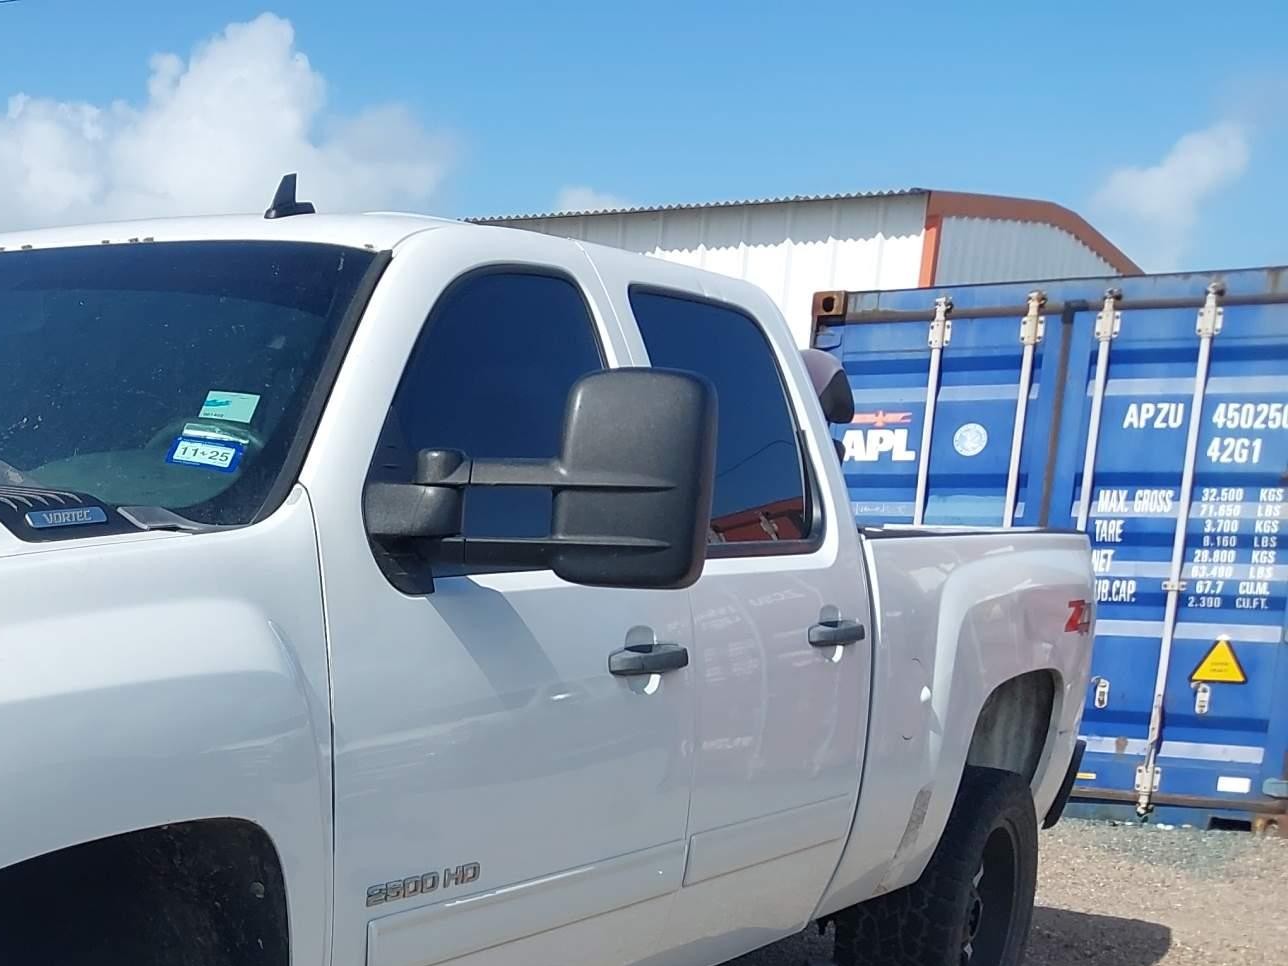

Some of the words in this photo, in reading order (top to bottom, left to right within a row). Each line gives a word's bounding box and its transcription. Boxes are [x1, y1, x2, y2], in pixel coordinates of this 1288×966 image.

[1123, 403, 1184, 429] APZU
[842, 428, 915, 462] APL
[1207, 437, 1262, 464] 42G1
[1097, 489, 1129, 512] MAX.
[1133, 489, 1174, 513] GROSS
[1201, 487, 1244, 502] 32.500
[1259, 488, 1284, 502] KGS
[1257, 504, 1281, 517] LBS
[43, 509, 92, 524] VORTEC
[1094, 519, 1124, 542] TARE
[1204, 519, 1239, 533] 3.700
[1255, 520, 1279, 534] KGS
[1253, 536, 1277, 548] LBS
[1091, 549, 1115, 572] NET
[1251, 550, 1276, 564] KGS
[1248, 566, 1273, 579] LBS
[1195, 580, 1224, 594] 67.7
[365, 871, 440, 908] 2500
[442, 861, 481, 889] HD
